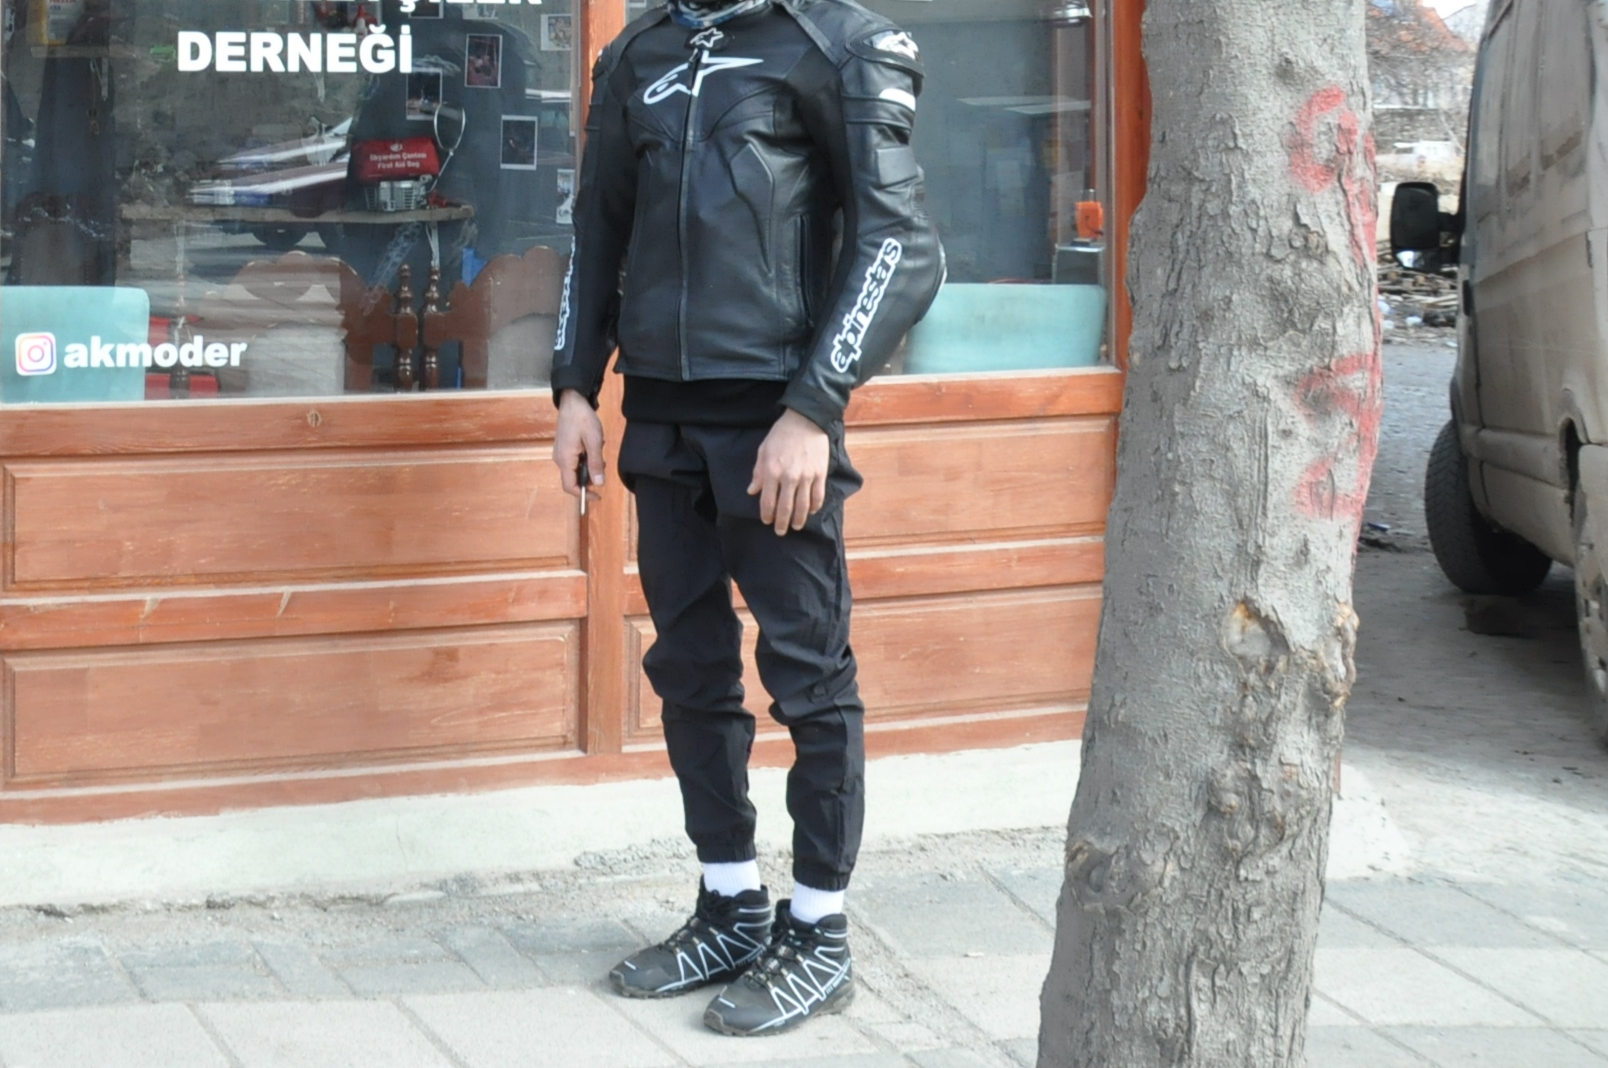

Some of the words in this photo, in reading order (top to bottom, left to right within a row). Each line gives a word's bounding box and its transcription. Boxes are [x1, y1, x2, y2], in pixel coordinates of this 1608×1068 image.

[177, 23, 413, 74] DERNEĞİ
[377, 161, 394, 170] First
[394, 160, 406, 169] Aid
[406, 160, 421, 169] Bag
[830, 237, 902, 373] alpinestars
[63, 335, 248, 368] akmoder
